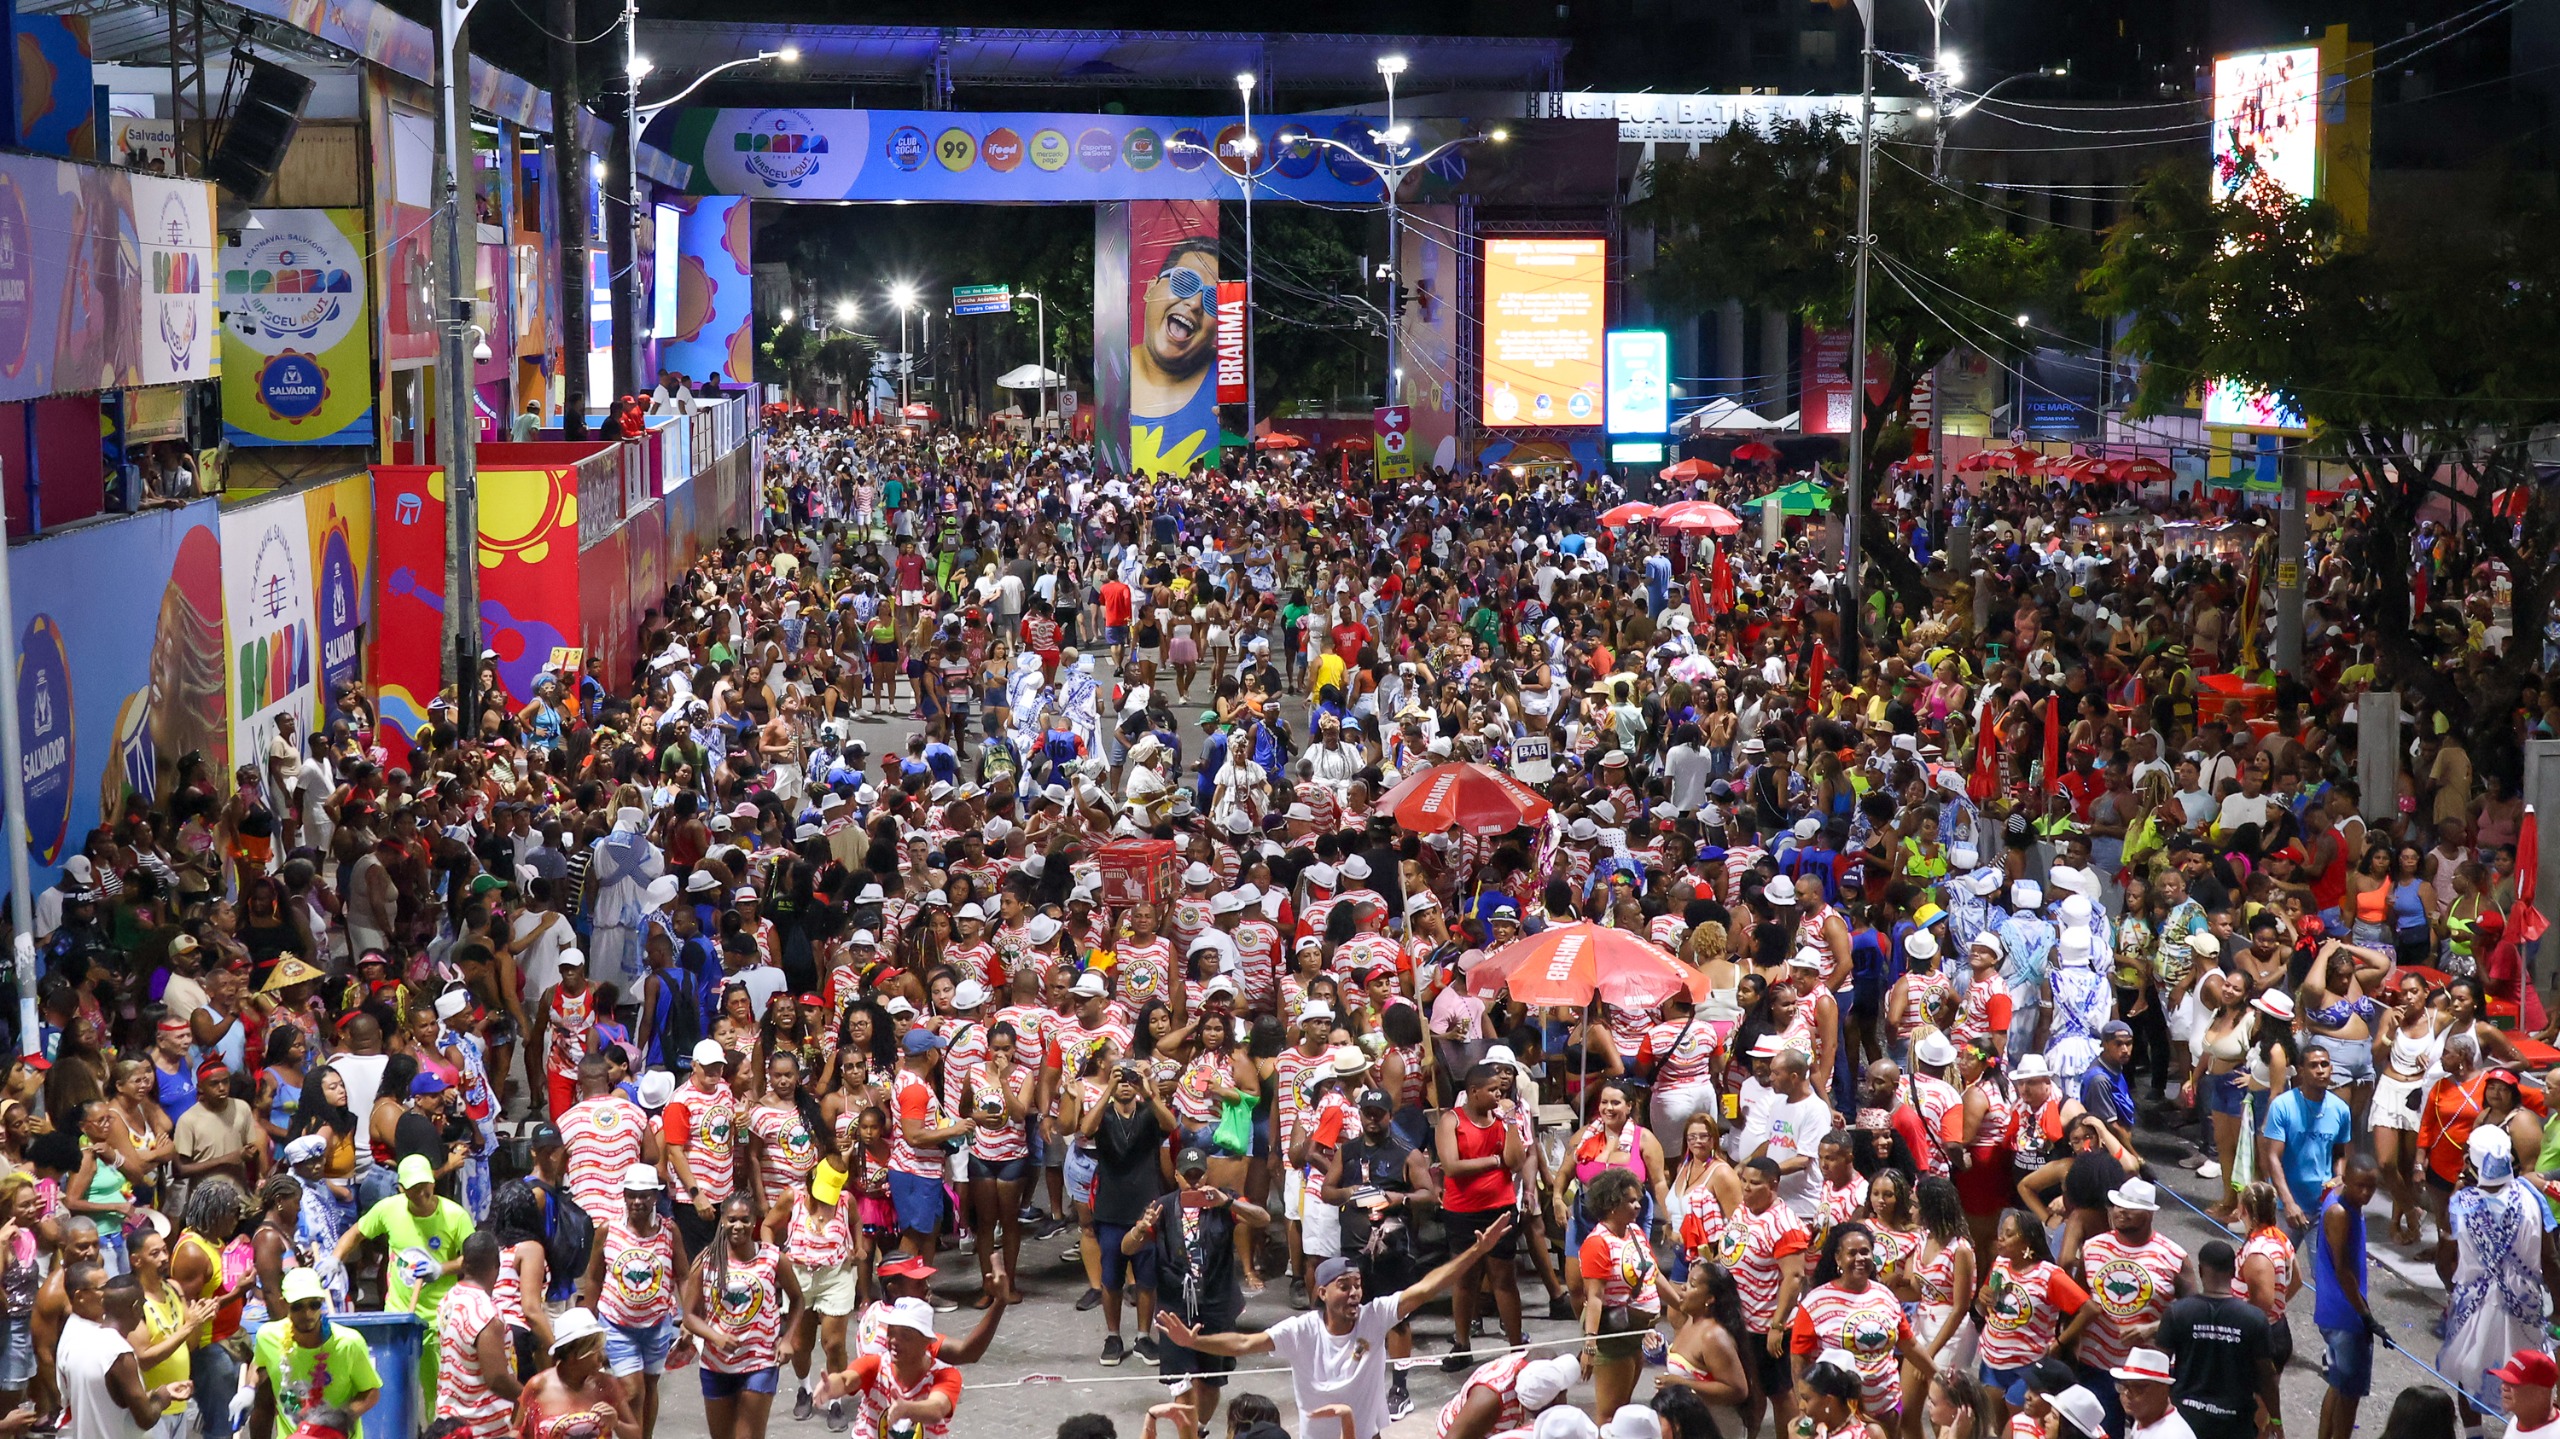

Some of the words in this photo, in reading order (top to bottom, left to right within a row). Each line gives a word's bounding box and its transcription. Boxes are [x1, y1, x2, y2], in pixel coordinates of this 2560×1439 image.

[1570, 99, 1669, 124] GREJA
[128, 128, 175, 143] Salvador
[898, 137, 917, 146] CLUB
[160, 147, 176, 159] TV
[943, 141, 968, 159] 99
[753, 155, 788, 178] NASCEU
[246, 233, 286, 259] CARNAVAL
[287, 233, 328, 257] SALVADOR
[0, 279, 25, 302] LVADOR
[251, 297, 297, 327] NASCEU
[300, 297, 329, 325] AQUI
[1218, 300, 1244, 386] BRAHMA
[269, 386, 316, 396] SALVADOR
[2027, 403, 2033, 411] 7
[2034, 403, 2046, 411] DE
[2048, 403, 2082, 412] MARÇO
[325, 630, 356, 669] SALVADOR
[23, 736, 66, 782] SALVADOR
[1518, 742, 1548, 758] BAR
[1421, 773, 1457, 813] BRAHMA
[1489, 770, 1535, 807] BRAHMA
[1477, 824, 1502, 834] BRAHMA
[1546, 934, 1588, 981] BRAHMA
[1772, 1119, 1794, 1135] GERA
[2097, 1263, 2149, 1285] MUTANTES
